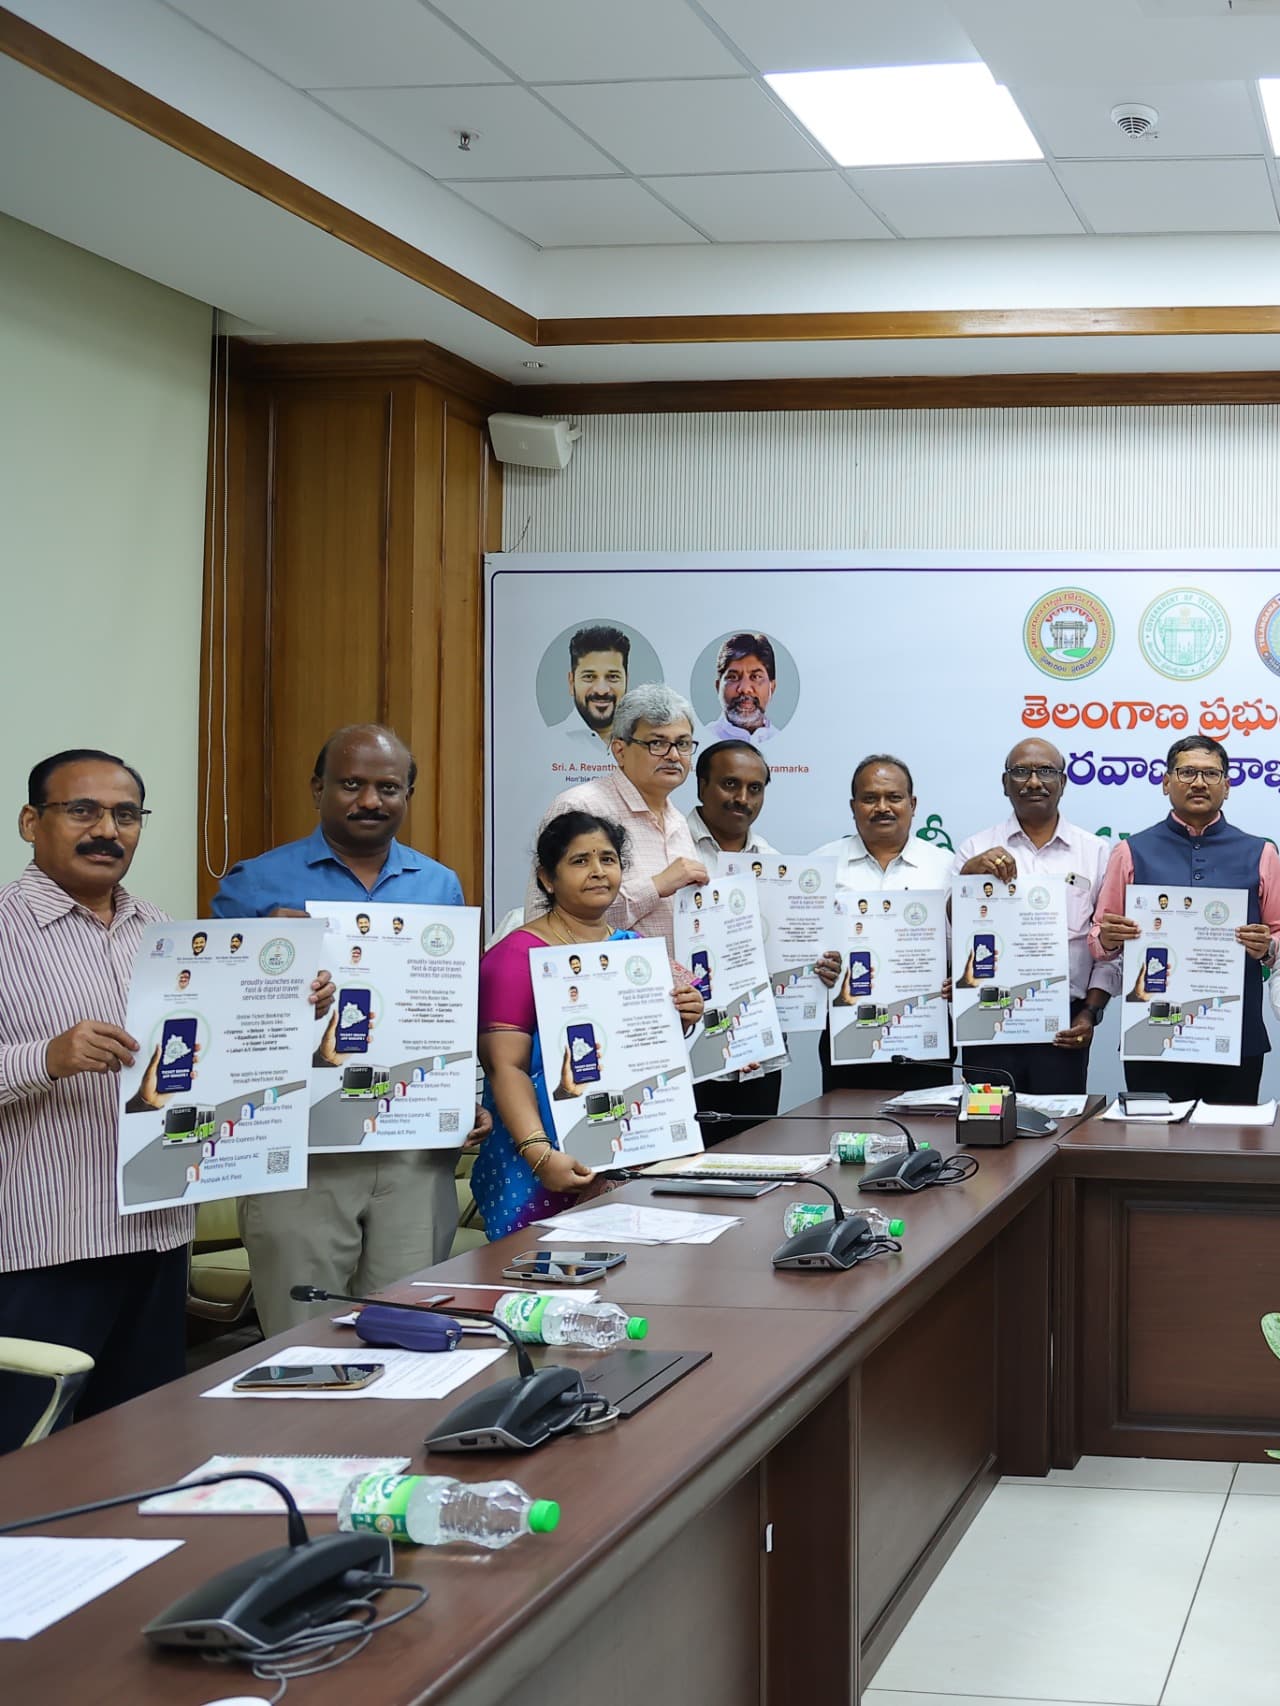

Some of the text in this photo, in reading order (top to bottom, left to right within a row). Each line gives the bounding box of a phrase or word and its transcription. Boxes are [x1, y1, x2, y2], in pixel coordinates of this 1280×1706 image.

[1146, 595, 1178, 632] GOVERNMENT
[1021, 695, 1189, 730] తెలంగాణ
[552, 763, 617, 772] Sri. A. Revanth
[769, 765, 809, 773] ramarka
